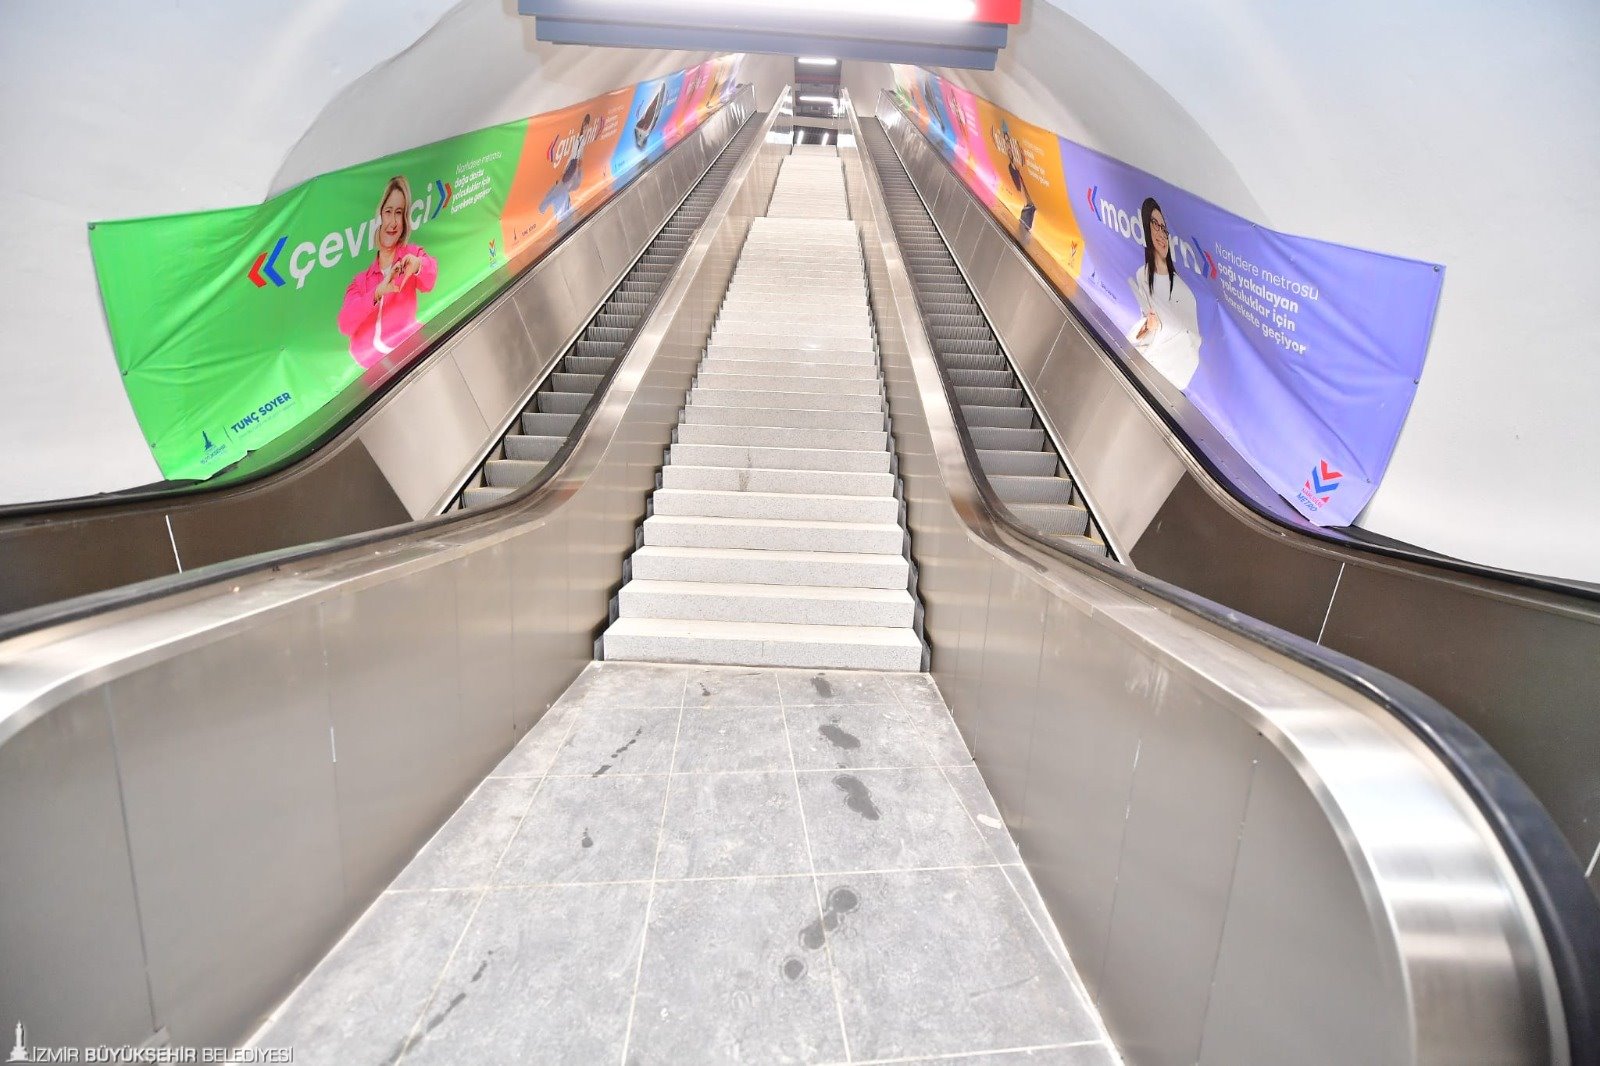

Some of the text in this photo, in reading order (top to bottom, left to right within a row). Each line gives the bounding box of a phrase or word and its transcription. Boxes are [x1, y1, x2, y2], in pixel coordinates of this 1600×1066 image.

[289, 183, 433, 290] çevrci
[1100, 198, 1202, 275] modrn
[1215, 242, 1319, 301] Narlıdere metrosu
[1217, 262, 1299, 314] çağı yakalayan
[1220, 278, 1296, 332] yolculuklar için
[1261, 323, 1307, 355] geçiyor
[231, 392, 292, 433] TUNÇ SOYER
[1296, 492, 1318, 512] METRO
